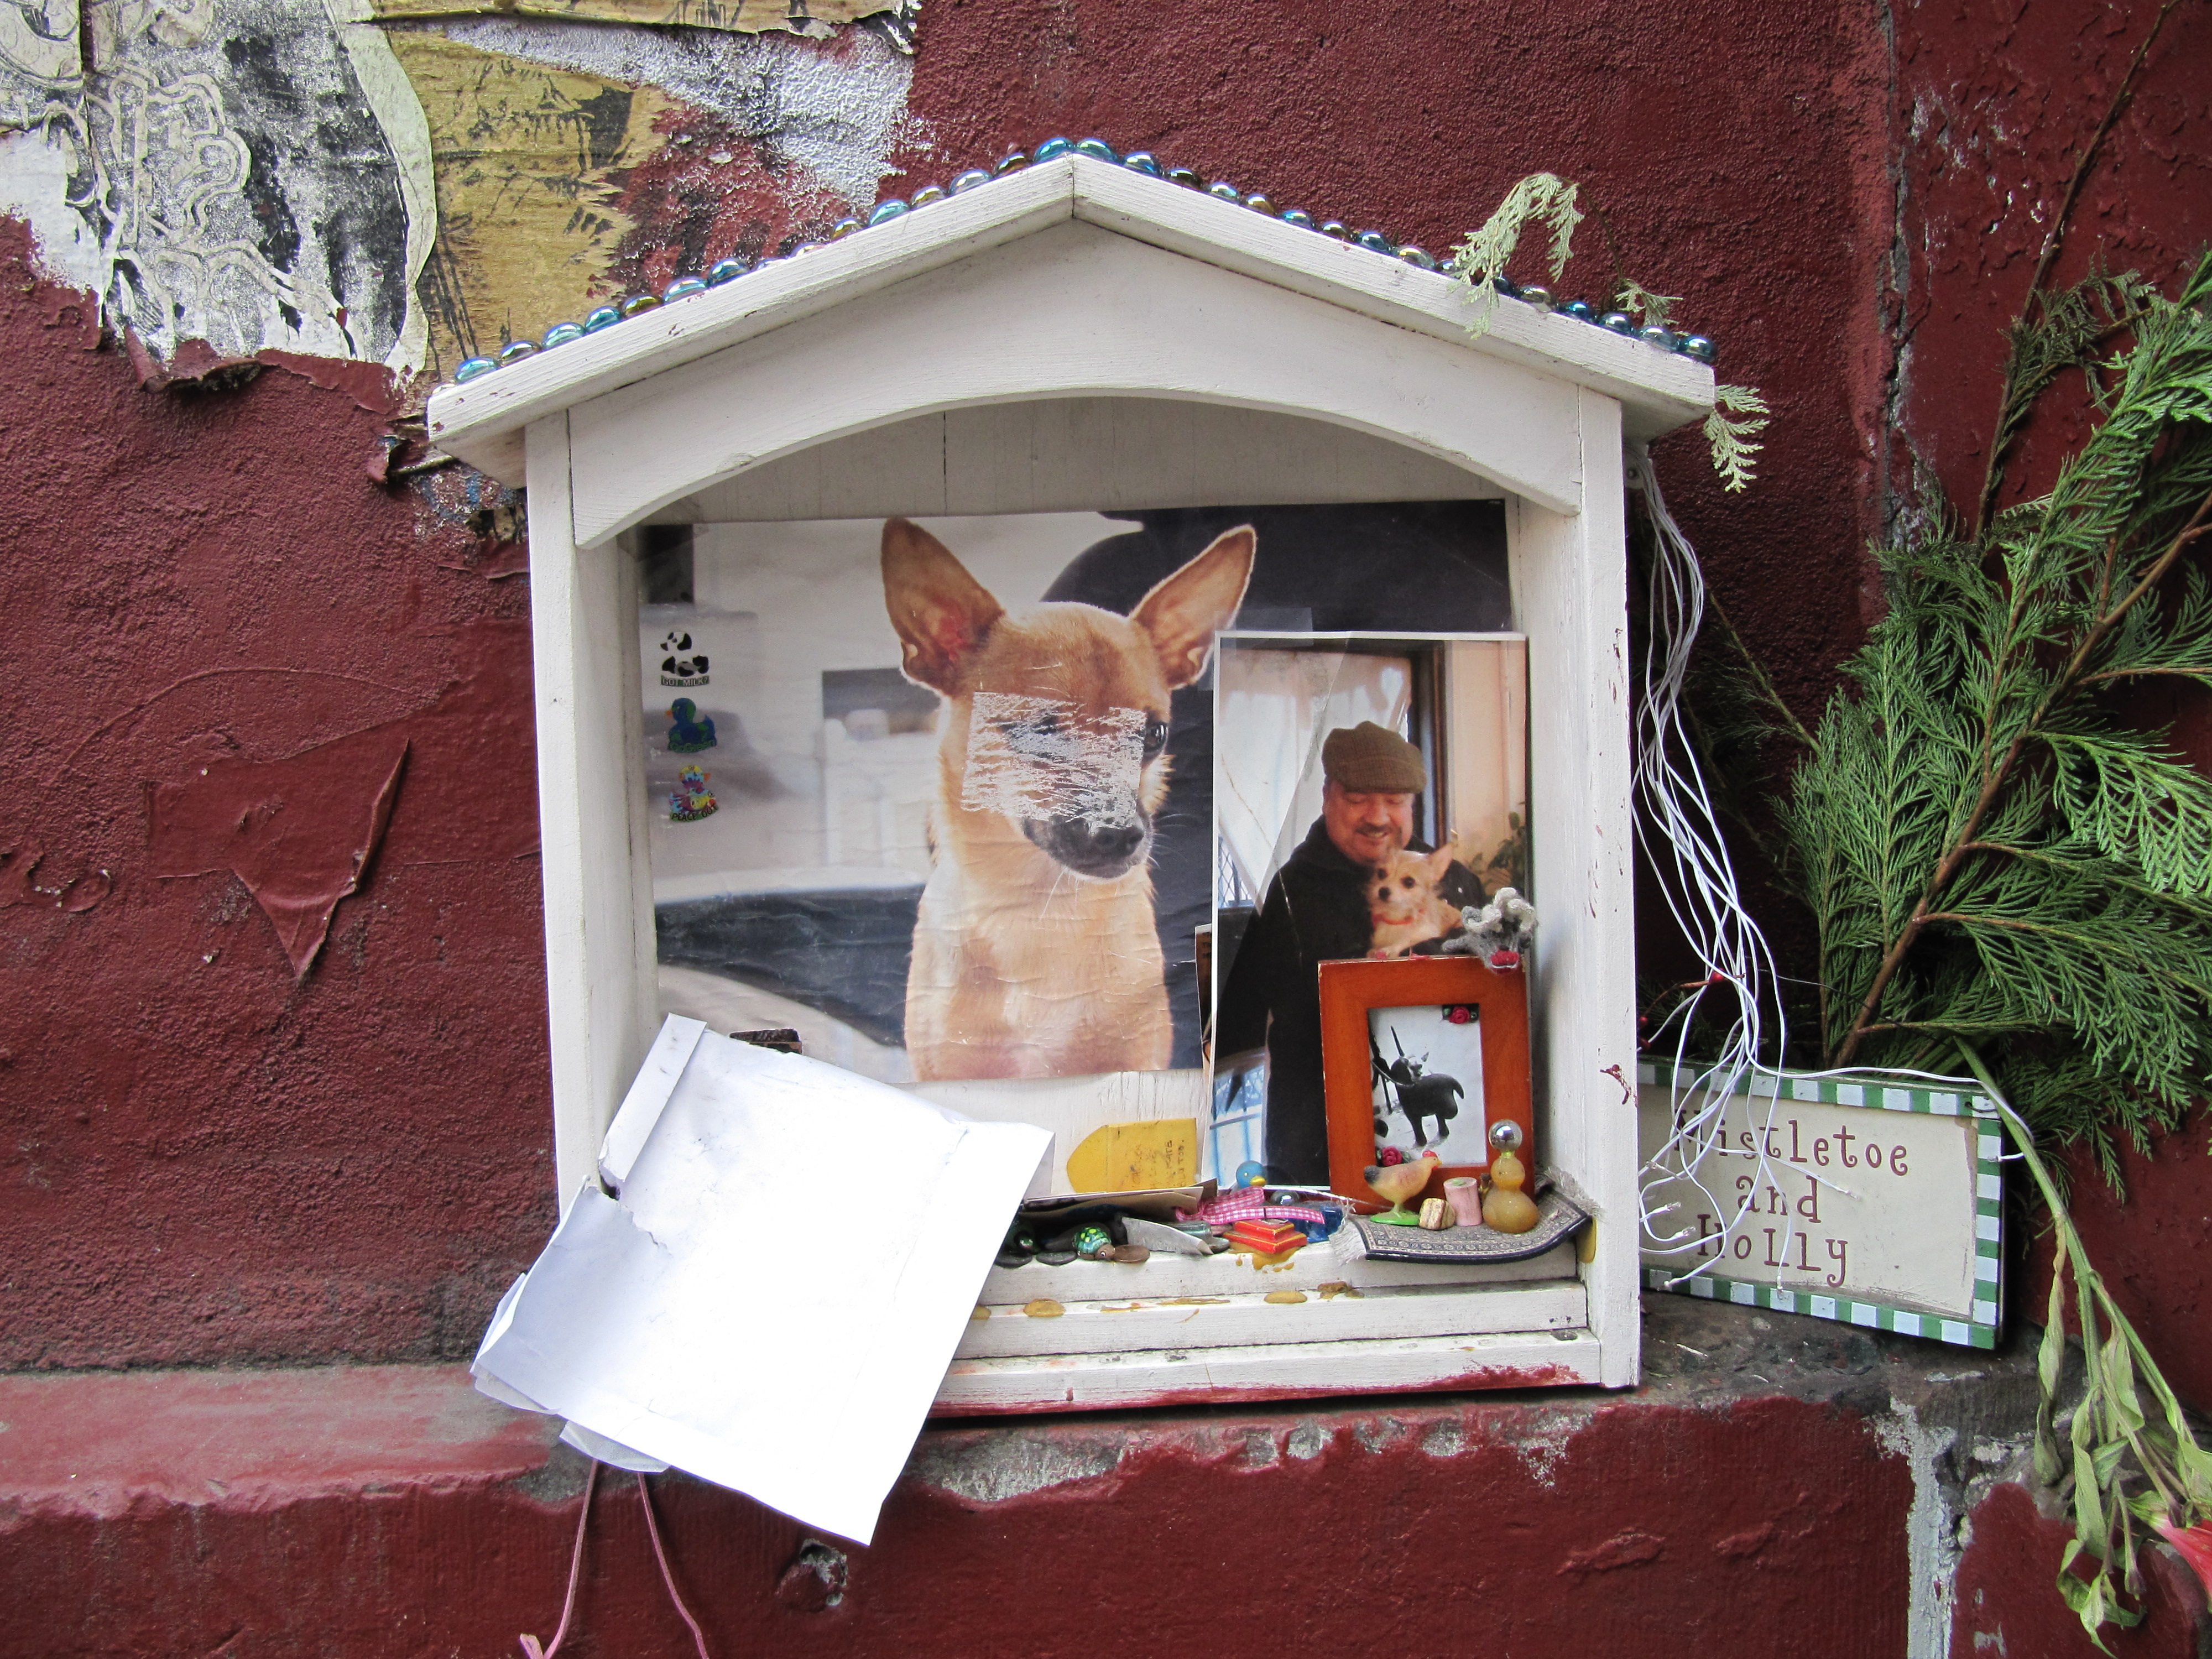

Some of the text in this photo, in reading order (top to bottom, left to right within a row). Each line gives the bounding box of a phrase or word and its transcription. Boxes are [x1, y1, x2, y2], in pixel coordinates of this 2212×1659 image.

[662, 676, 708, 686] GOT MILK?
[671, 812, 697, 821] PEACE
[1736, 1175, 1822, 1223] and
[1697, 1214, 1849, 1288] Holly
